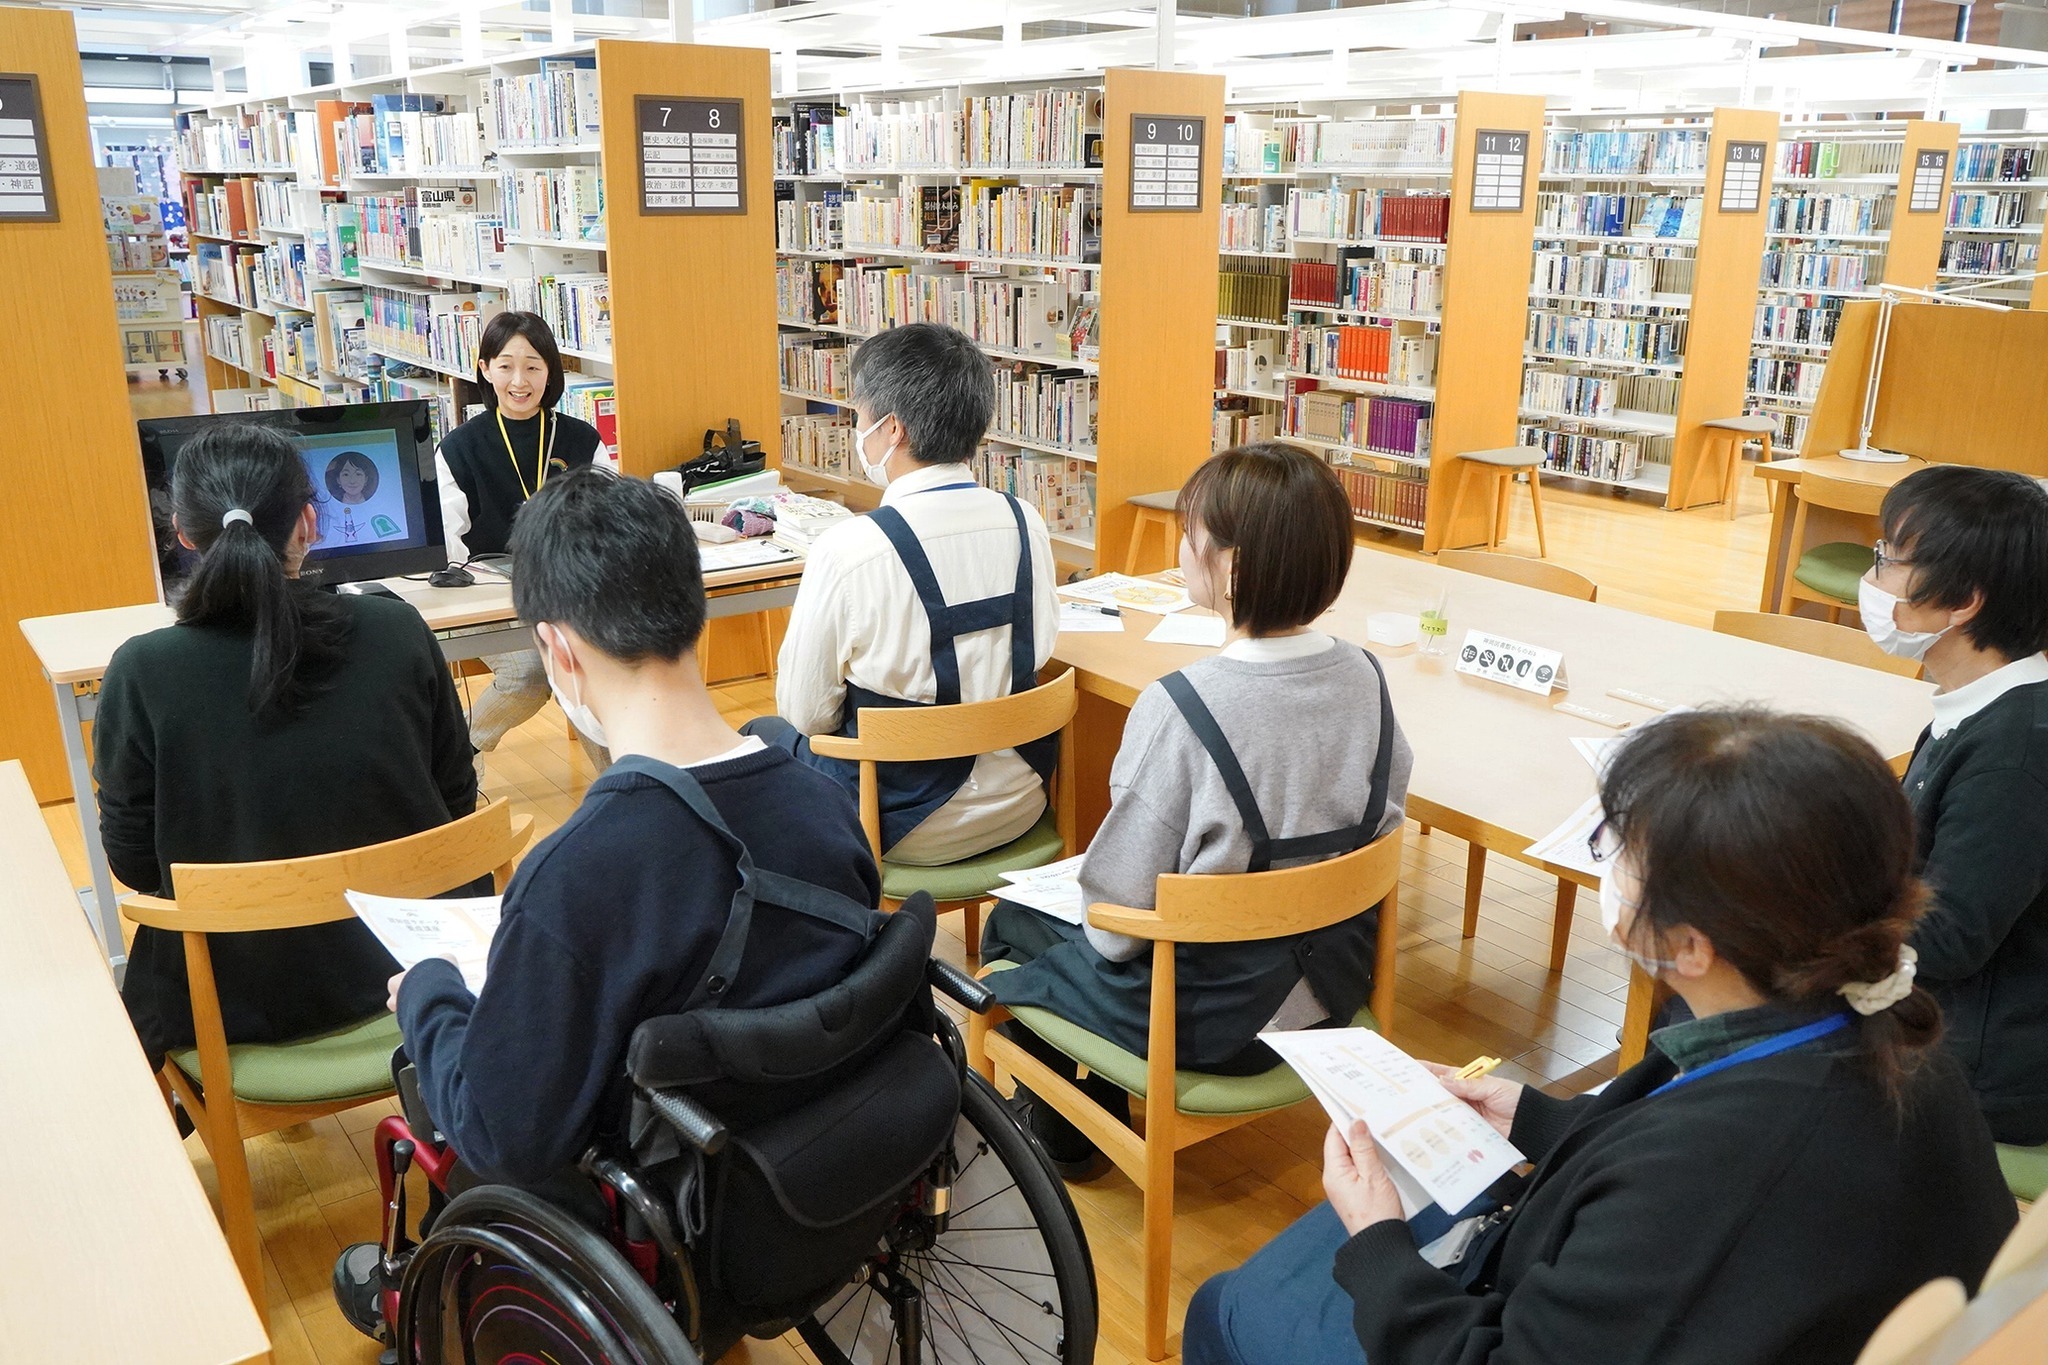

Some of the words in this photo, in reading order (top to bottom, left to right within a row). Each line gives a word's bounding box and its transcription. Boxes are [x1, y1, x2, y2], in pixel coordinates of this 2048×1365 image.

[659, 107, 672, 127] 7
[708, 108, 721, 128] 8
[1147, 122, 1157, 140] 9
[1177, 124, 1193, 141] 10
[1485, 136, 1496, 151] 11
[1508, 137, 1521, 152] 12
[1732, 146, 1742, 160] 13
[1750, 148, 1760, 160] 14
[1922, 154, 1930, 166] 15
[1935, 155, 1944, 166] 16
[420, 190, 456, 202] 富山県
